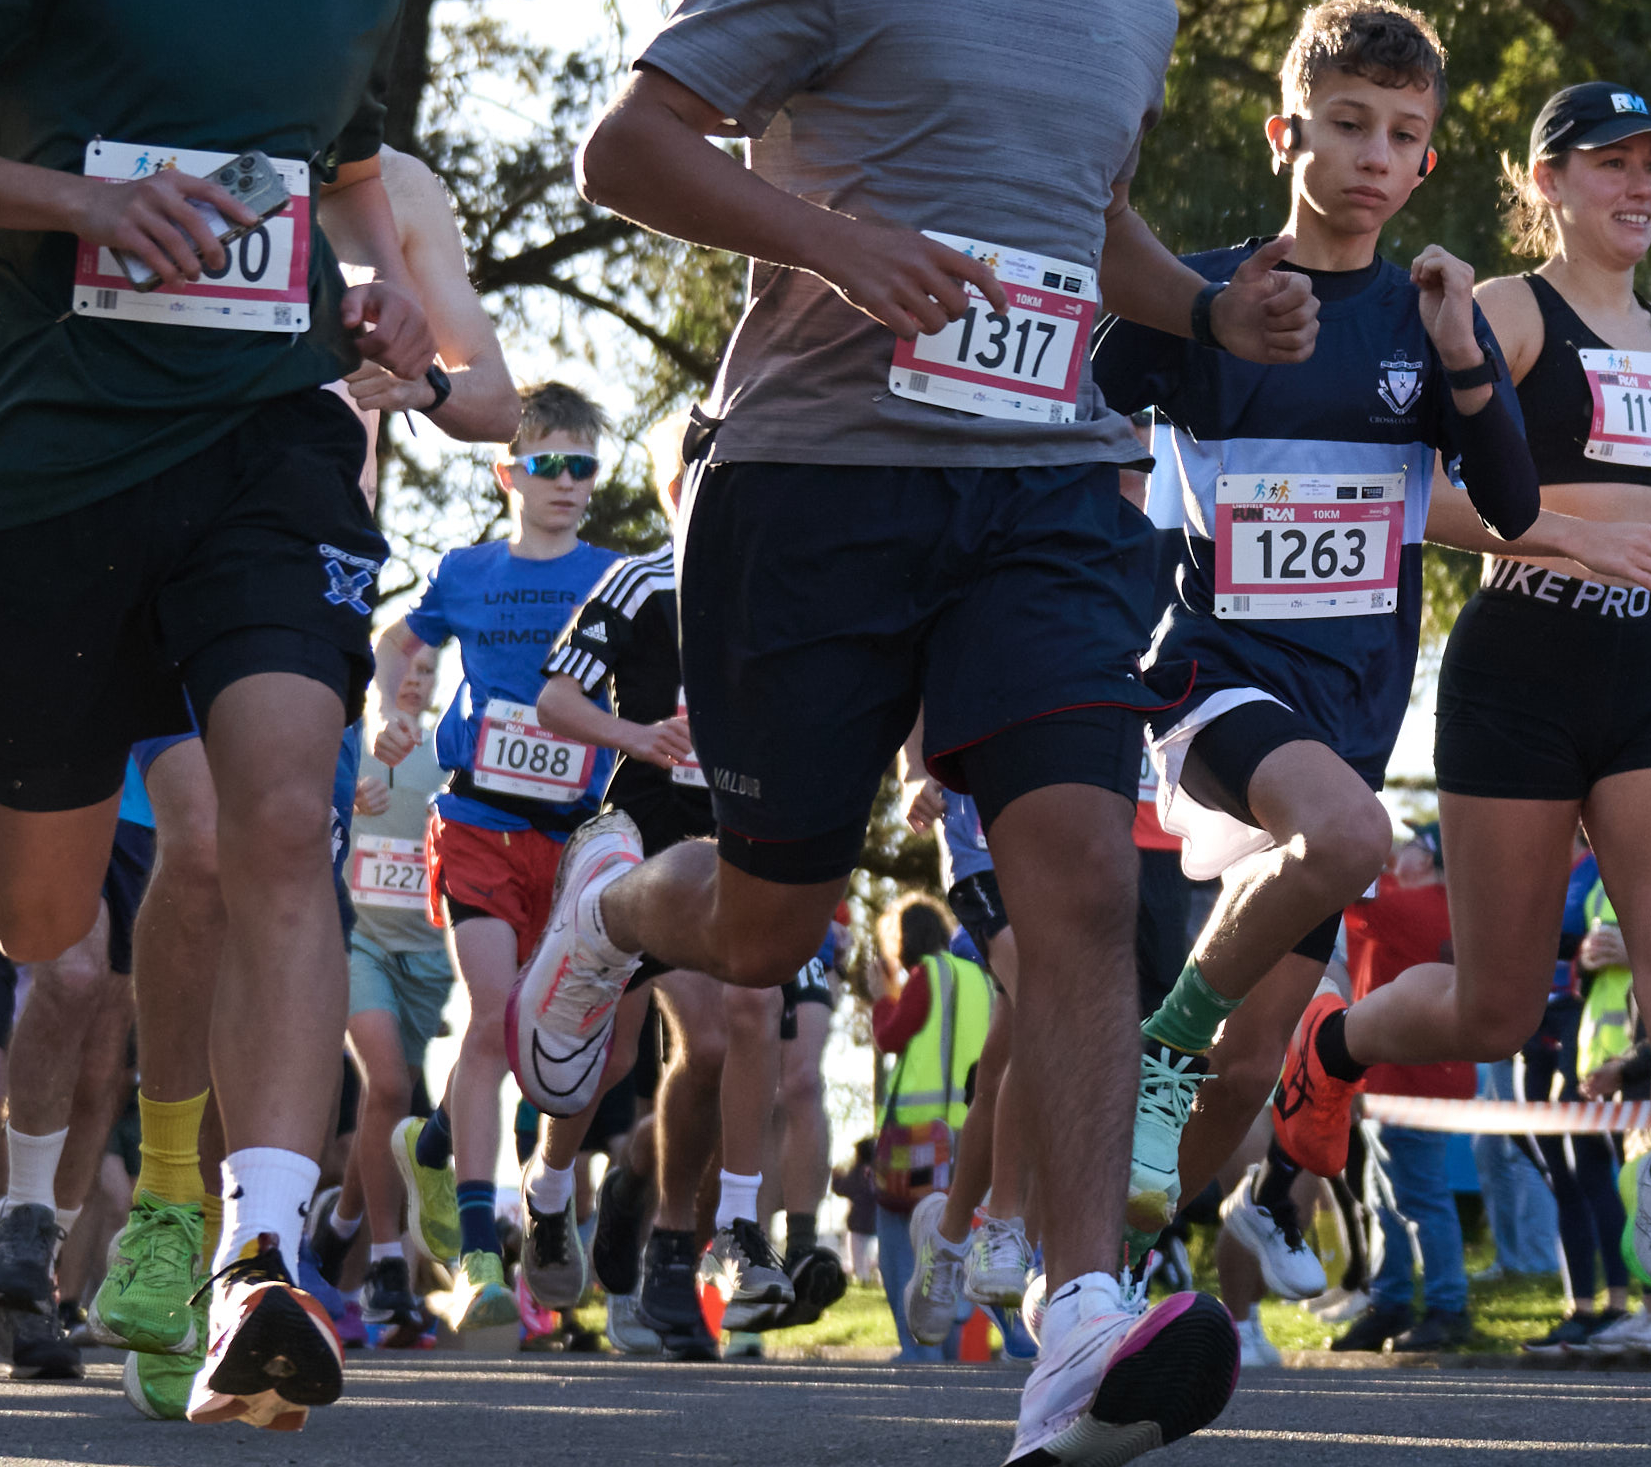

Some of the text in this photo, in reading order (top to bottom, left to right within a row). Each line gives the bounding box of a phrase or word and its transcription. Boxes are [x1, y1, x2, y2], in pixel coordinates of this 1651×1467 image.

[1611, 93, 1648, 112] RM
[1016, 293, 1043, 308] 10KM
[957, 306, 1057, 378] 1317
[1232, 507, 1341, 522] FUN RUN 10KM
[1256, 528, 1367, 579] 1263
[484, 589, 577, 605] UNDER
[1480, 558, 1571, 604] NIKE
[1571, 580, 1650, 619] PRO
[478, 628, 559, 647] ARMO
[496, 736, 571, 777] 1088
[374, 863, 427, 891] 1227
